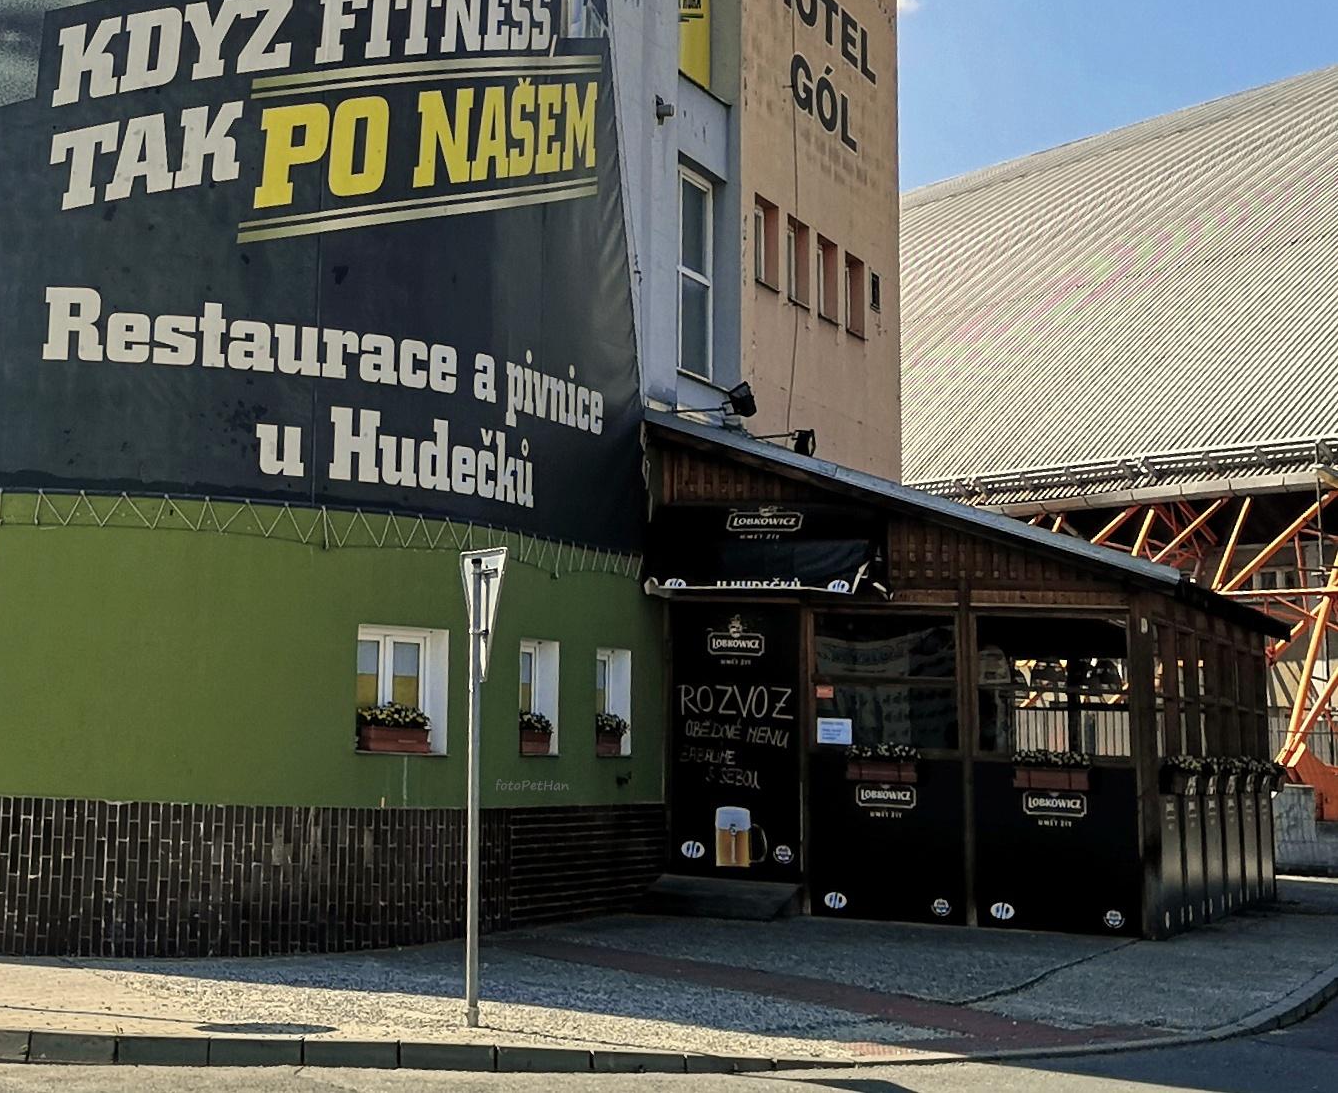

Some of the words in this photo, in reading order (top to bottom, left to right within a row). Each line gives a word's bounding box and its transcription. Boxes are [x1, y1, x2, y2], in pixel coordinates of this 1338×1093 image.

[790, 54, 857, 152] GÓL
[50, 100, 244, 211] TAK
[253, 96, 389, 209] PO
[412, 77, 598, 188] NAŠEM
[42, 287, 458, 394] Restaurace
[473, 352, 496, 403] a
[506, 349, 603, 435] pivnice
[256, 423, 304, 477] u
[329, 406, 534, 508] Hudečků
[733, 516, 797, 527] LOBKOWICZ
[712, 638, 760, 649] LOBKOWICZ
[679, 684, 794, 720] ROZVOZ
[745, 725, 790, 748] MENU
[860, 788, 911, 801] LOBKOWICZ
[1028, 796, 1082, 809] LOBKOWICZ
